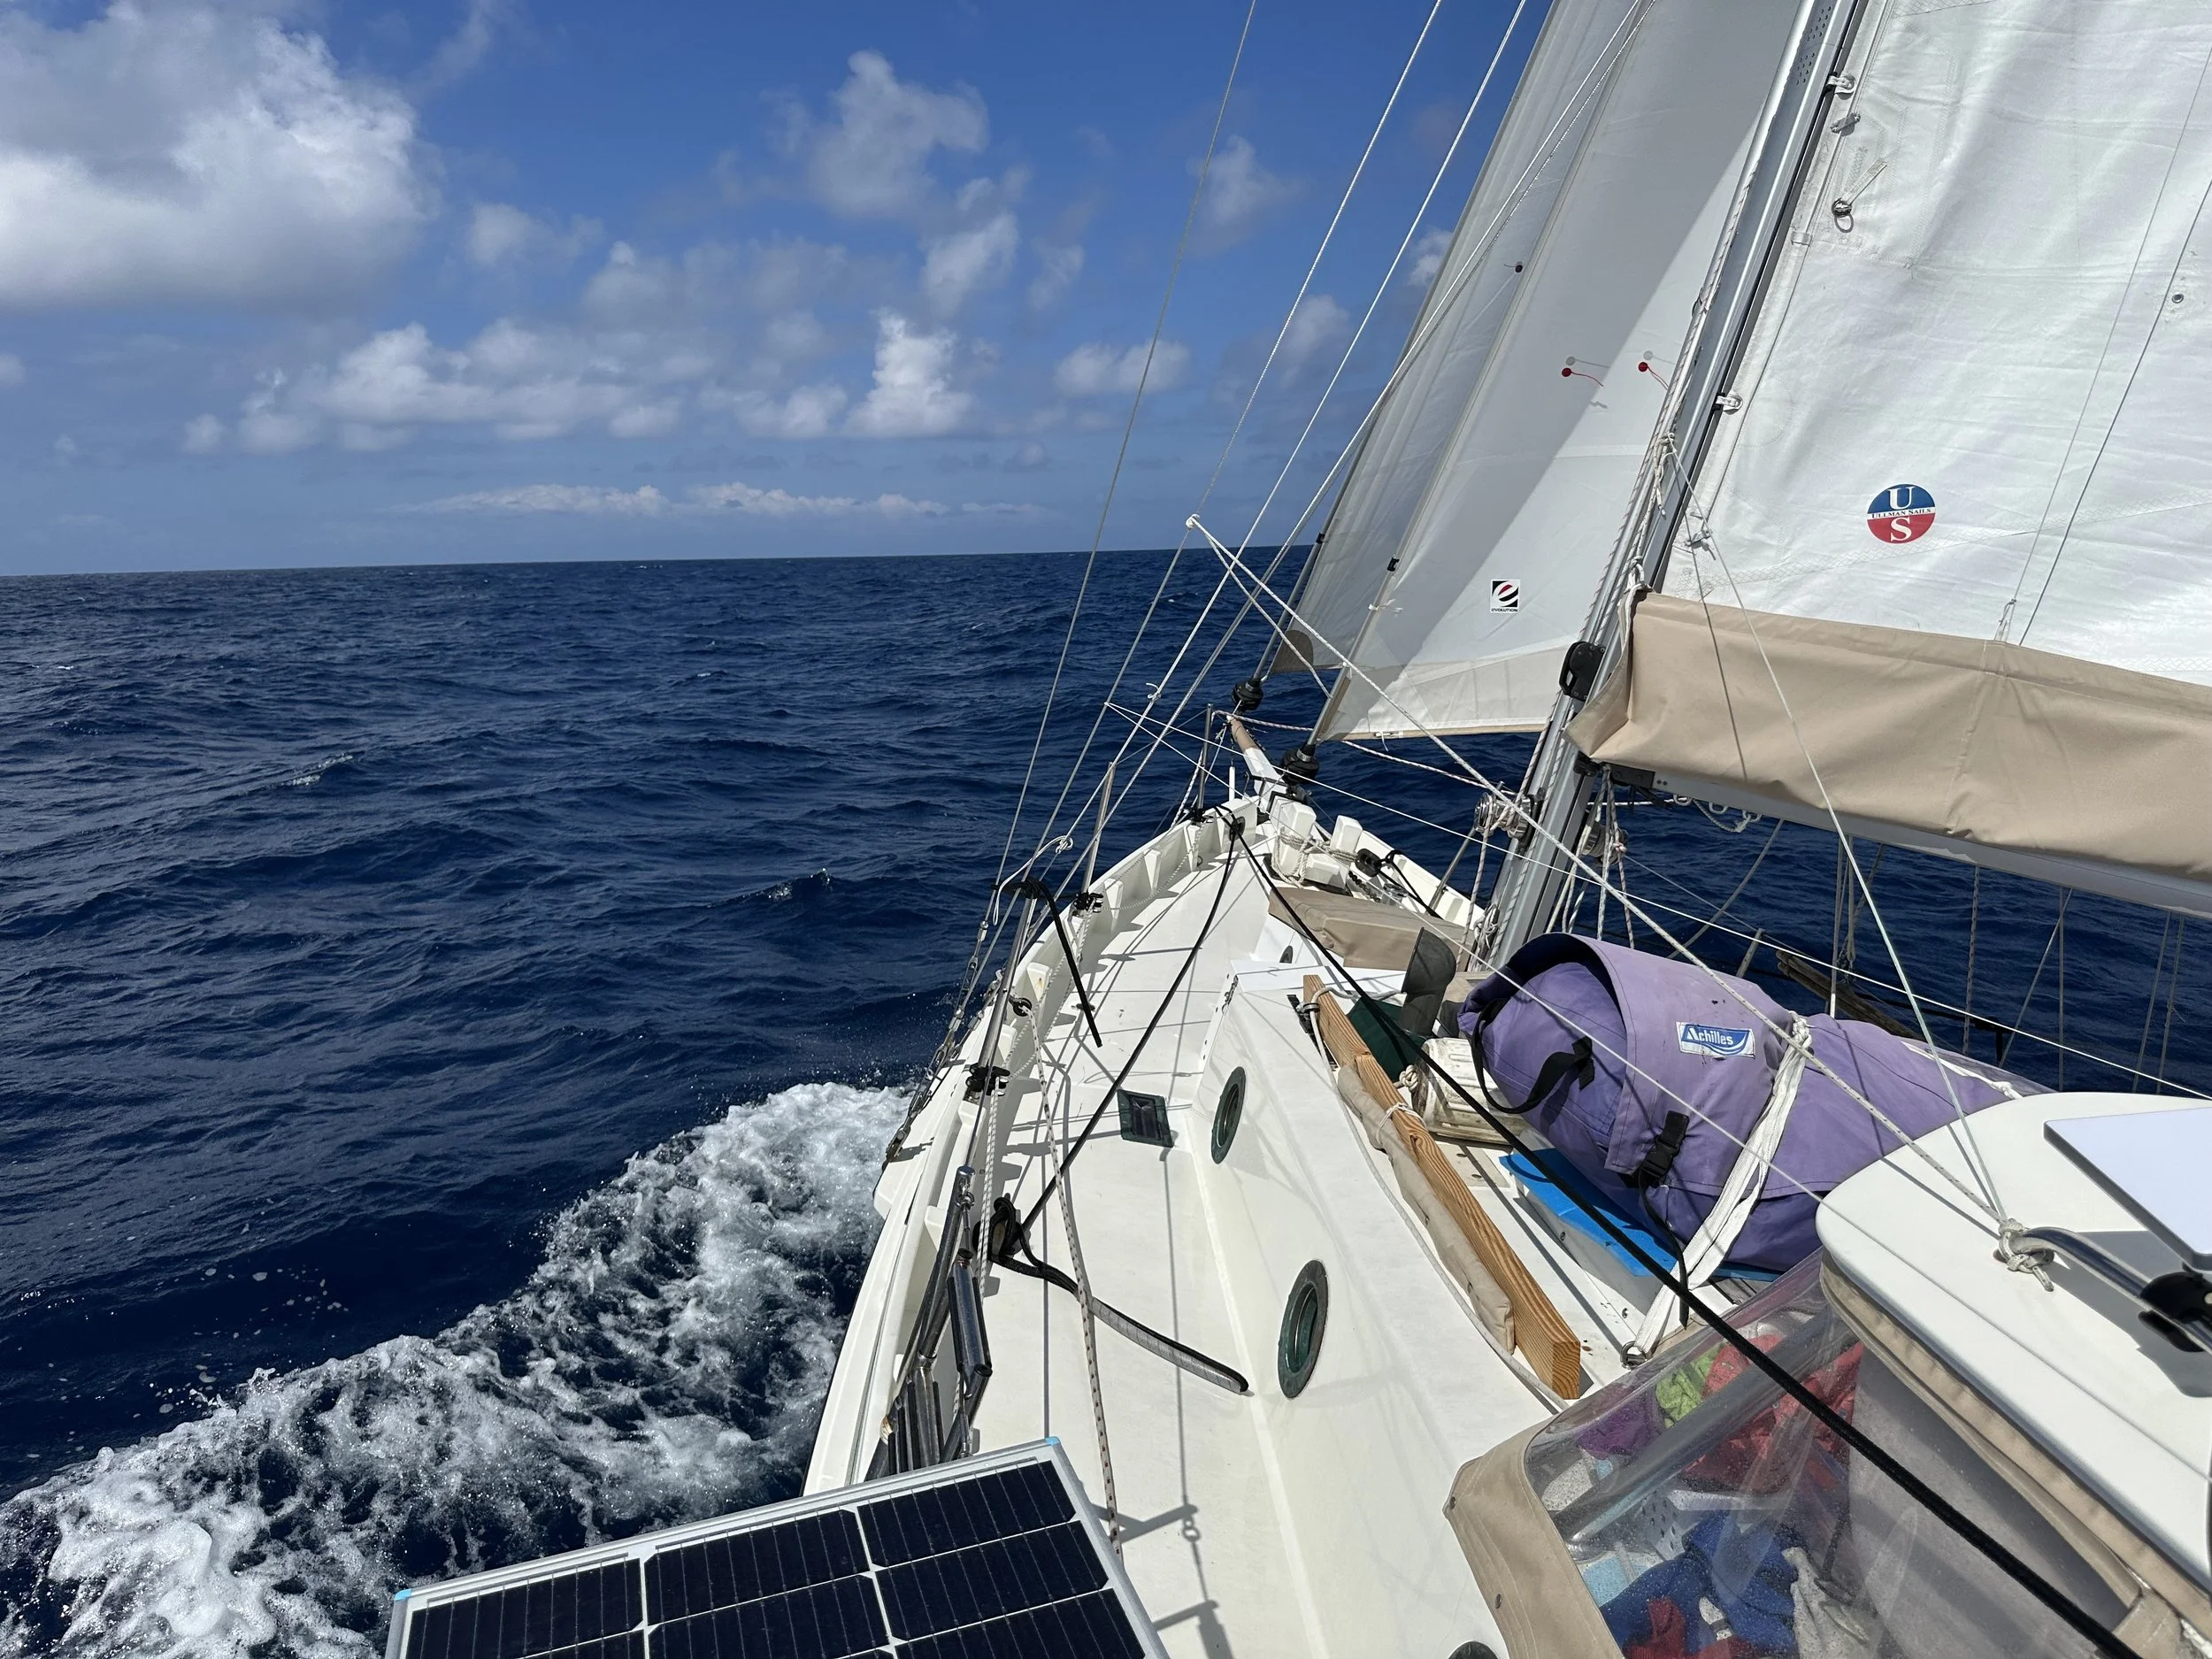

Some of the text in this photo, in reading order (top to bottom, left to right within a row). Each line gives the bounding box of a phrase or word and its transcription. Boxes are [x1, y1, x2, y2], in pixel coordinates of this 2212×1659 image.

[1887, 486, 1916, 511] U
[1890, 517, 1912, 541] S
[1686, 1027, 1734, 1045] Achilles
